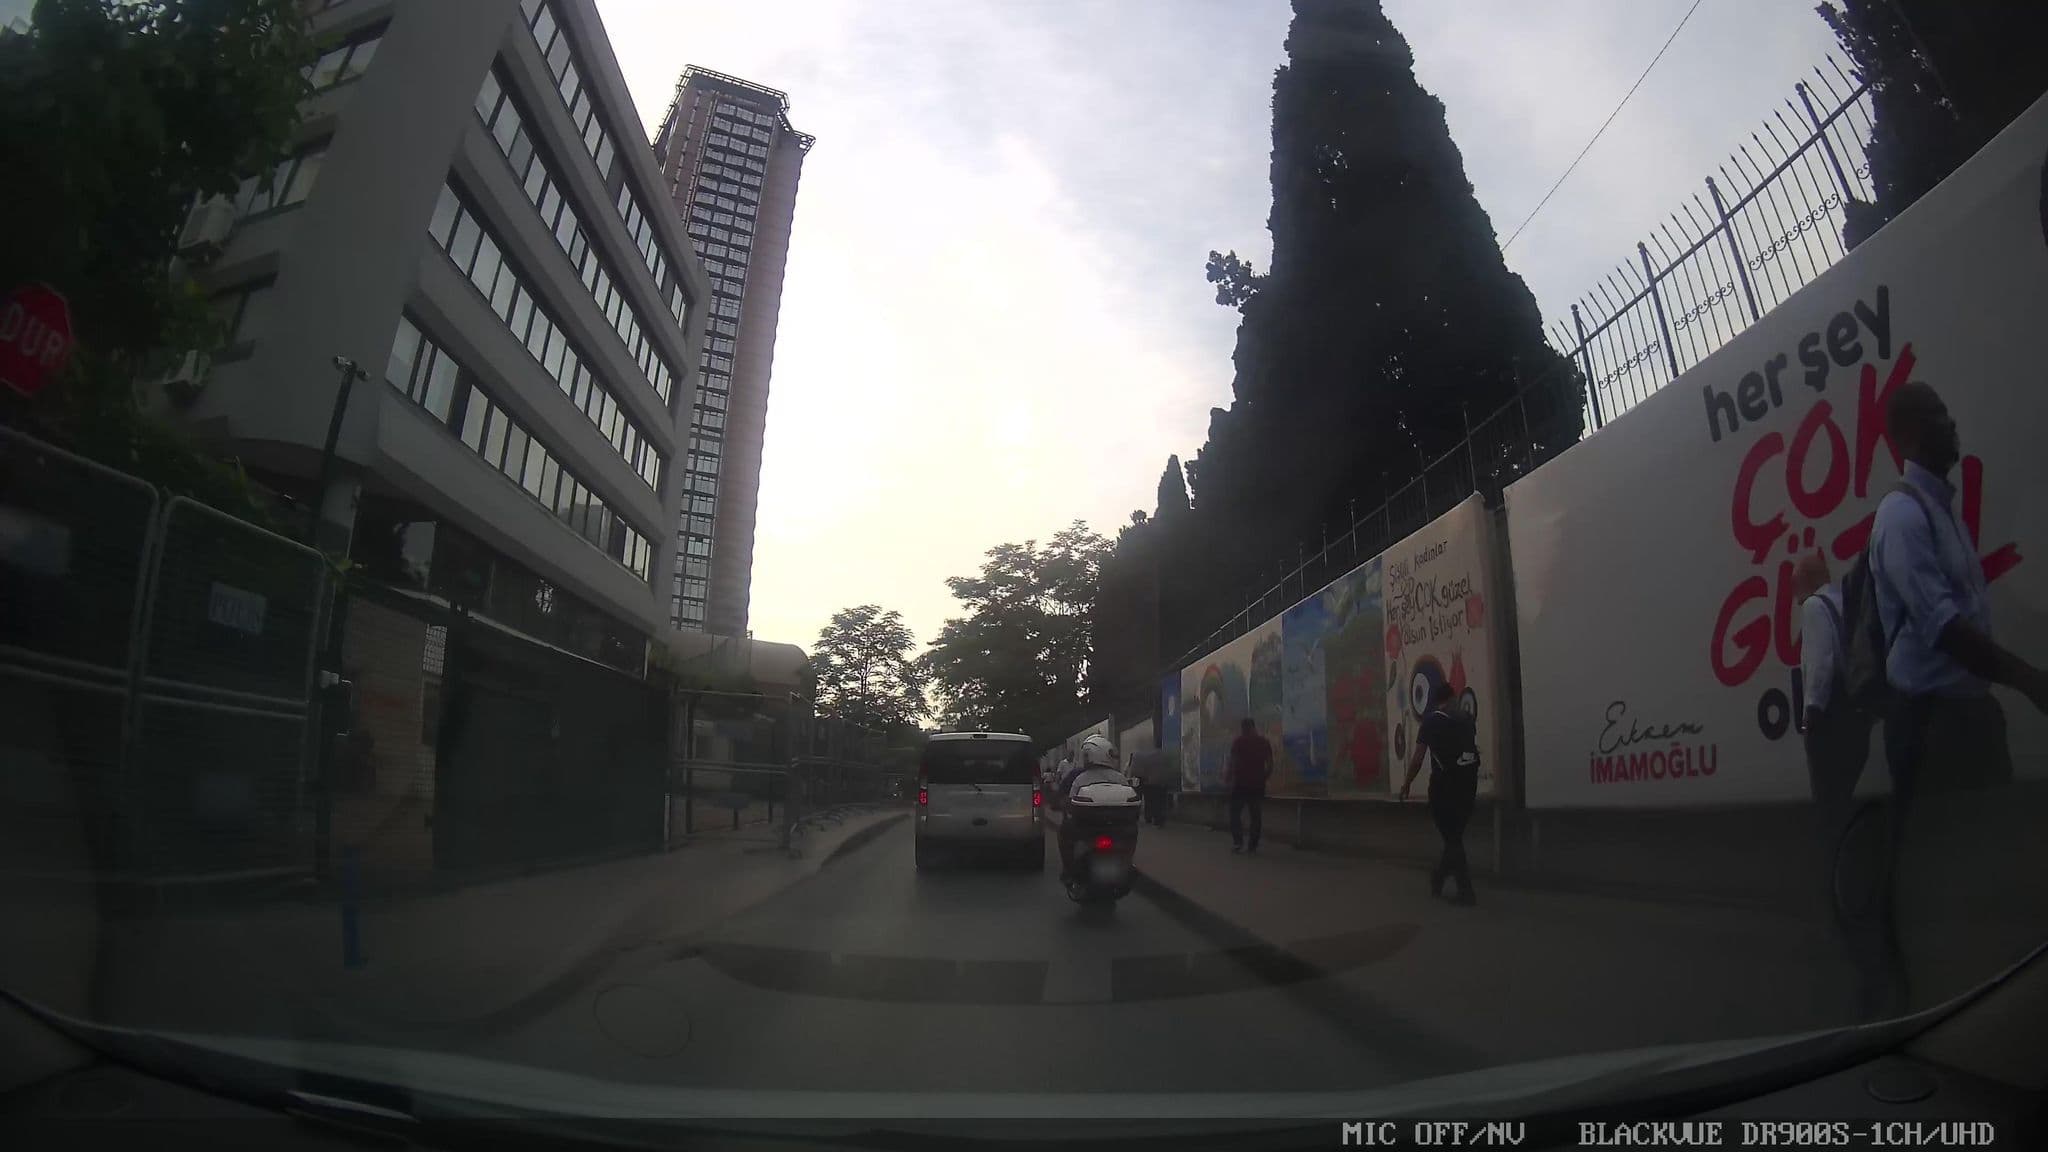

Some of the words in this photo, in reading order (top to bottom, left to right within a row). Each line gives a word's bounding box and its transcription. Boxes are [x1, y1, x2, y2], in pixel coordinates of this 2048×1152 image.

[0, 302, 66, 367] DUR
[1704, 353, 1787, 442] her
[1799, 285, 1890, 392] şey
[1732, 342, 1916, 564] ÇOK
[1599, 701, 1703, 754] Ekrem
[1590, 742, 1717, 784] İMAMOĞLU
